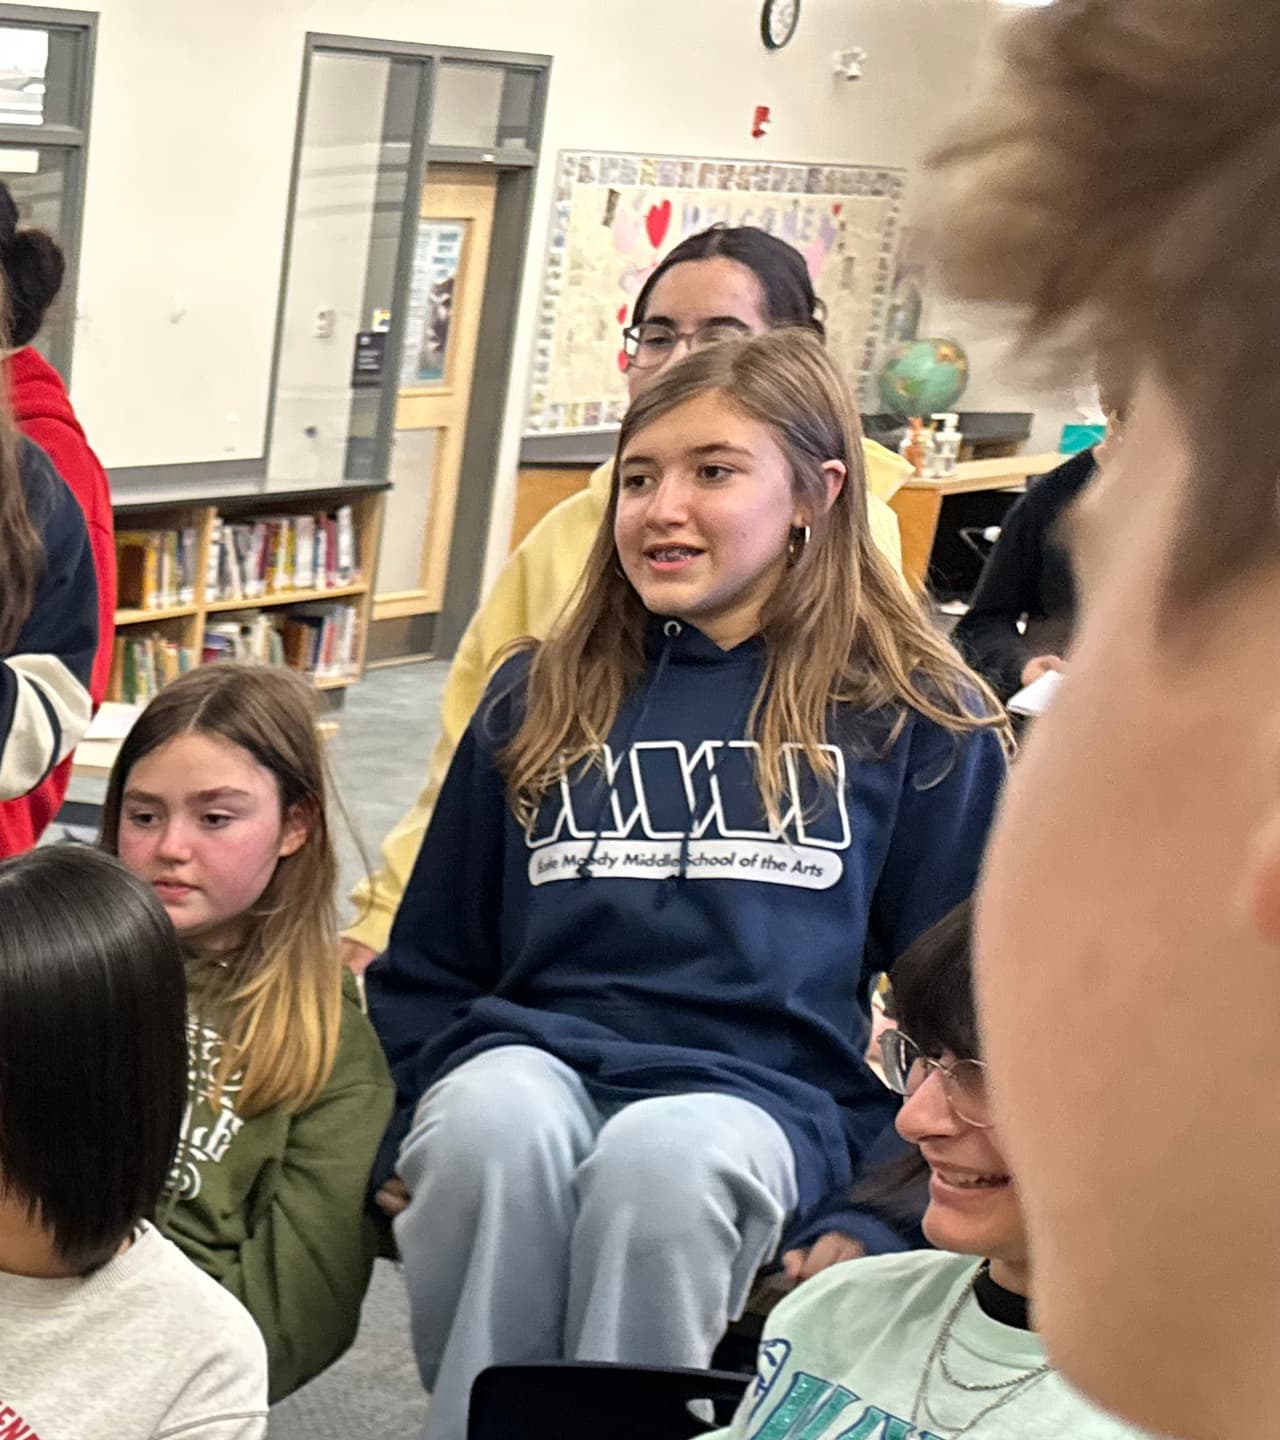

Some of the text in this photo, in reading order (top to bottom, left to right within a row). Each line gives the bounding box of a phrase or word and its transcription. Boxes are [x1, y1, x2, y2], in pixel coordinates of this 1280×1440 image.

[740, 852, 759, 868] of
[760, 854, 786, 873] the
[790, 860, 825, 878] Arts
